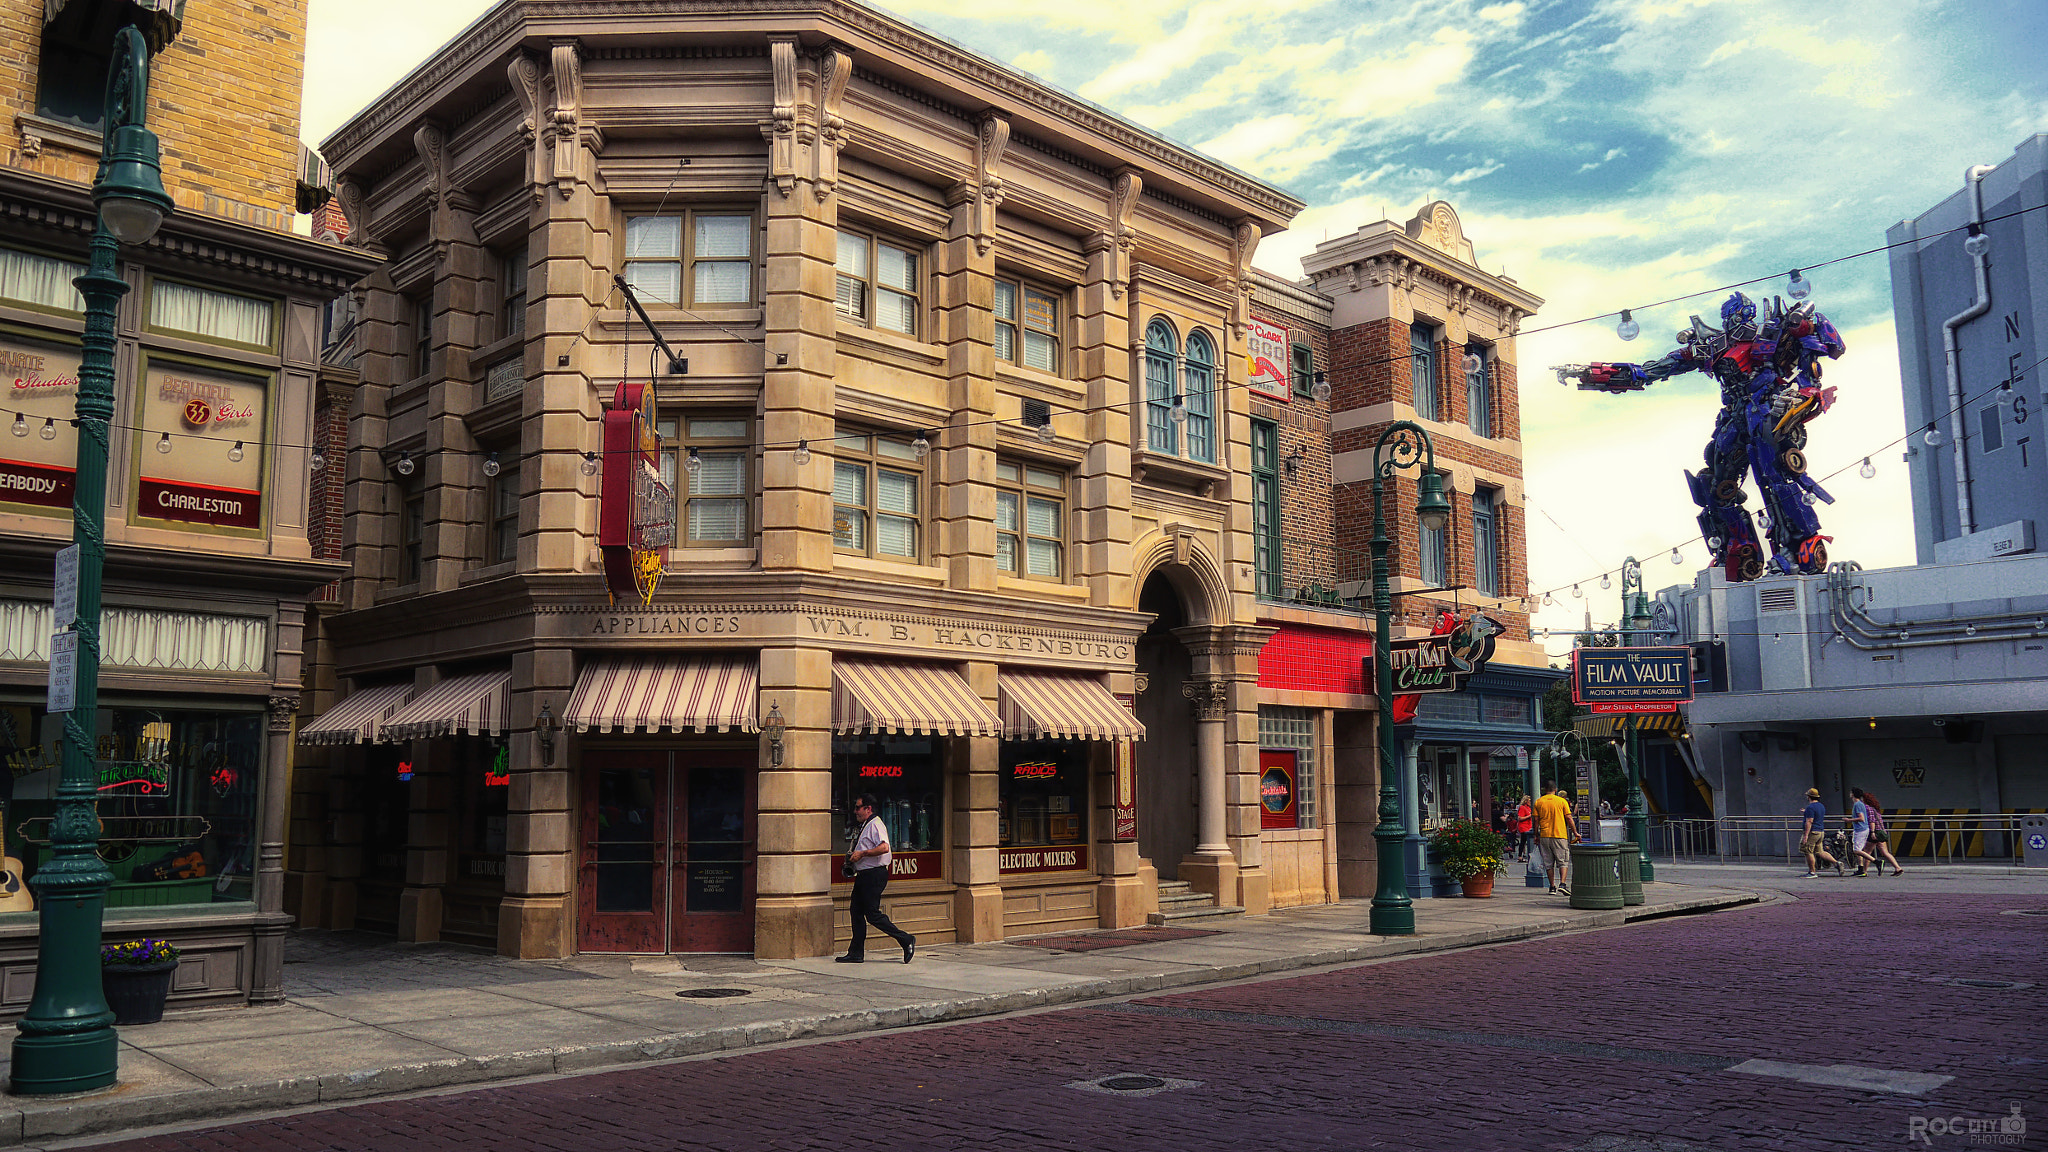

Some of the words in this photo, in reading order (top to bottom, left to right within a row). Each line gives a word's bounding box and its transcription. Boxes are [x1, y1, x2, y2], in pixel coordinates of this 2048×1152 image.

[1255, 325, 1283, 345] CLARK
[11, 372, 79, 389] Studios
[163, 375, 235, 402] BEAUTIFUL
[2004, 310, 2030, 468] NEST
[215, 404, 254, 422] Girls
[158, 491, 242, 515] CHARLESTON
[593, 616, 740, 634] APPLIANCES
[807, 616, 870, 637] WM.
[890, 624, 916, 641] B.
[934, 628, 1130, 660] HACKENBURG
[1418, 641, 1448, 668] KAT
[1627, 653, 1641, 663] THE
[1398, 664, 1450, 689] Club
[1586, 664, 1628, 683] FILM
[1631, 663, 1683, 683] VAULT
[1642, 688, 1683, 696] MEMORABILIA
[1634, 703, 1673, 711] PROPRIETOR
[860, 766, 903, 777] SWEEPERS
[1014, 766, 1057, 776] RADIOS
[1894, 758, 1922, 767] NEST
[1896, 769, 1903, 779] 7
[1916, 769, 1924, 778] 7
[1117, 808, 1135, 819] STAGE
[892, 858, 919, 876] FANS
[1000, 853, 1041, 870] ELECTRIC
[1044, 850, 1077, 868] MIXERS
